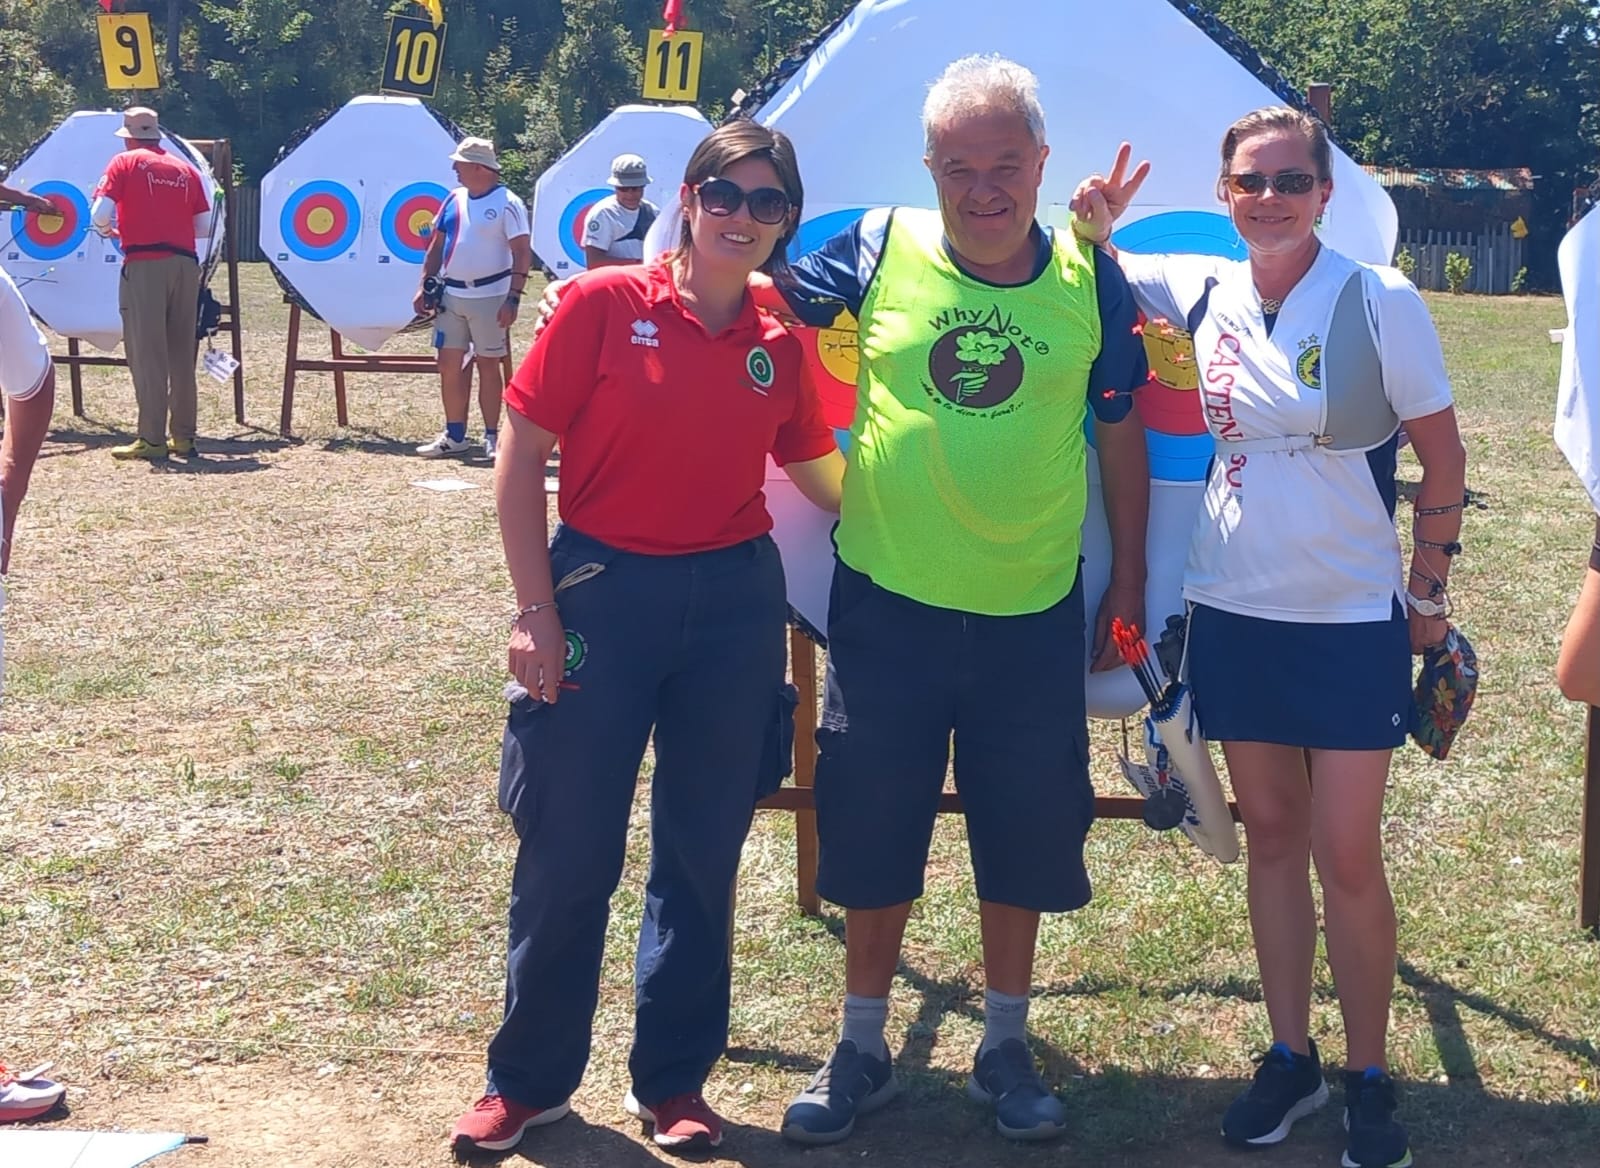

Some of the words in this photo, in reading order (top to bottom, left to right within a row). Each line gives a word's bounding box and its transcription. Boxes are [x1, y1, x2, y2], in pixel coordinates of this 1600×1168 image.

[116, 25, 142, 77] 9
[394, 28, 438, 85] 10
[656, 40, 691, 91] 11
[928, 306, 984, 331] Why
